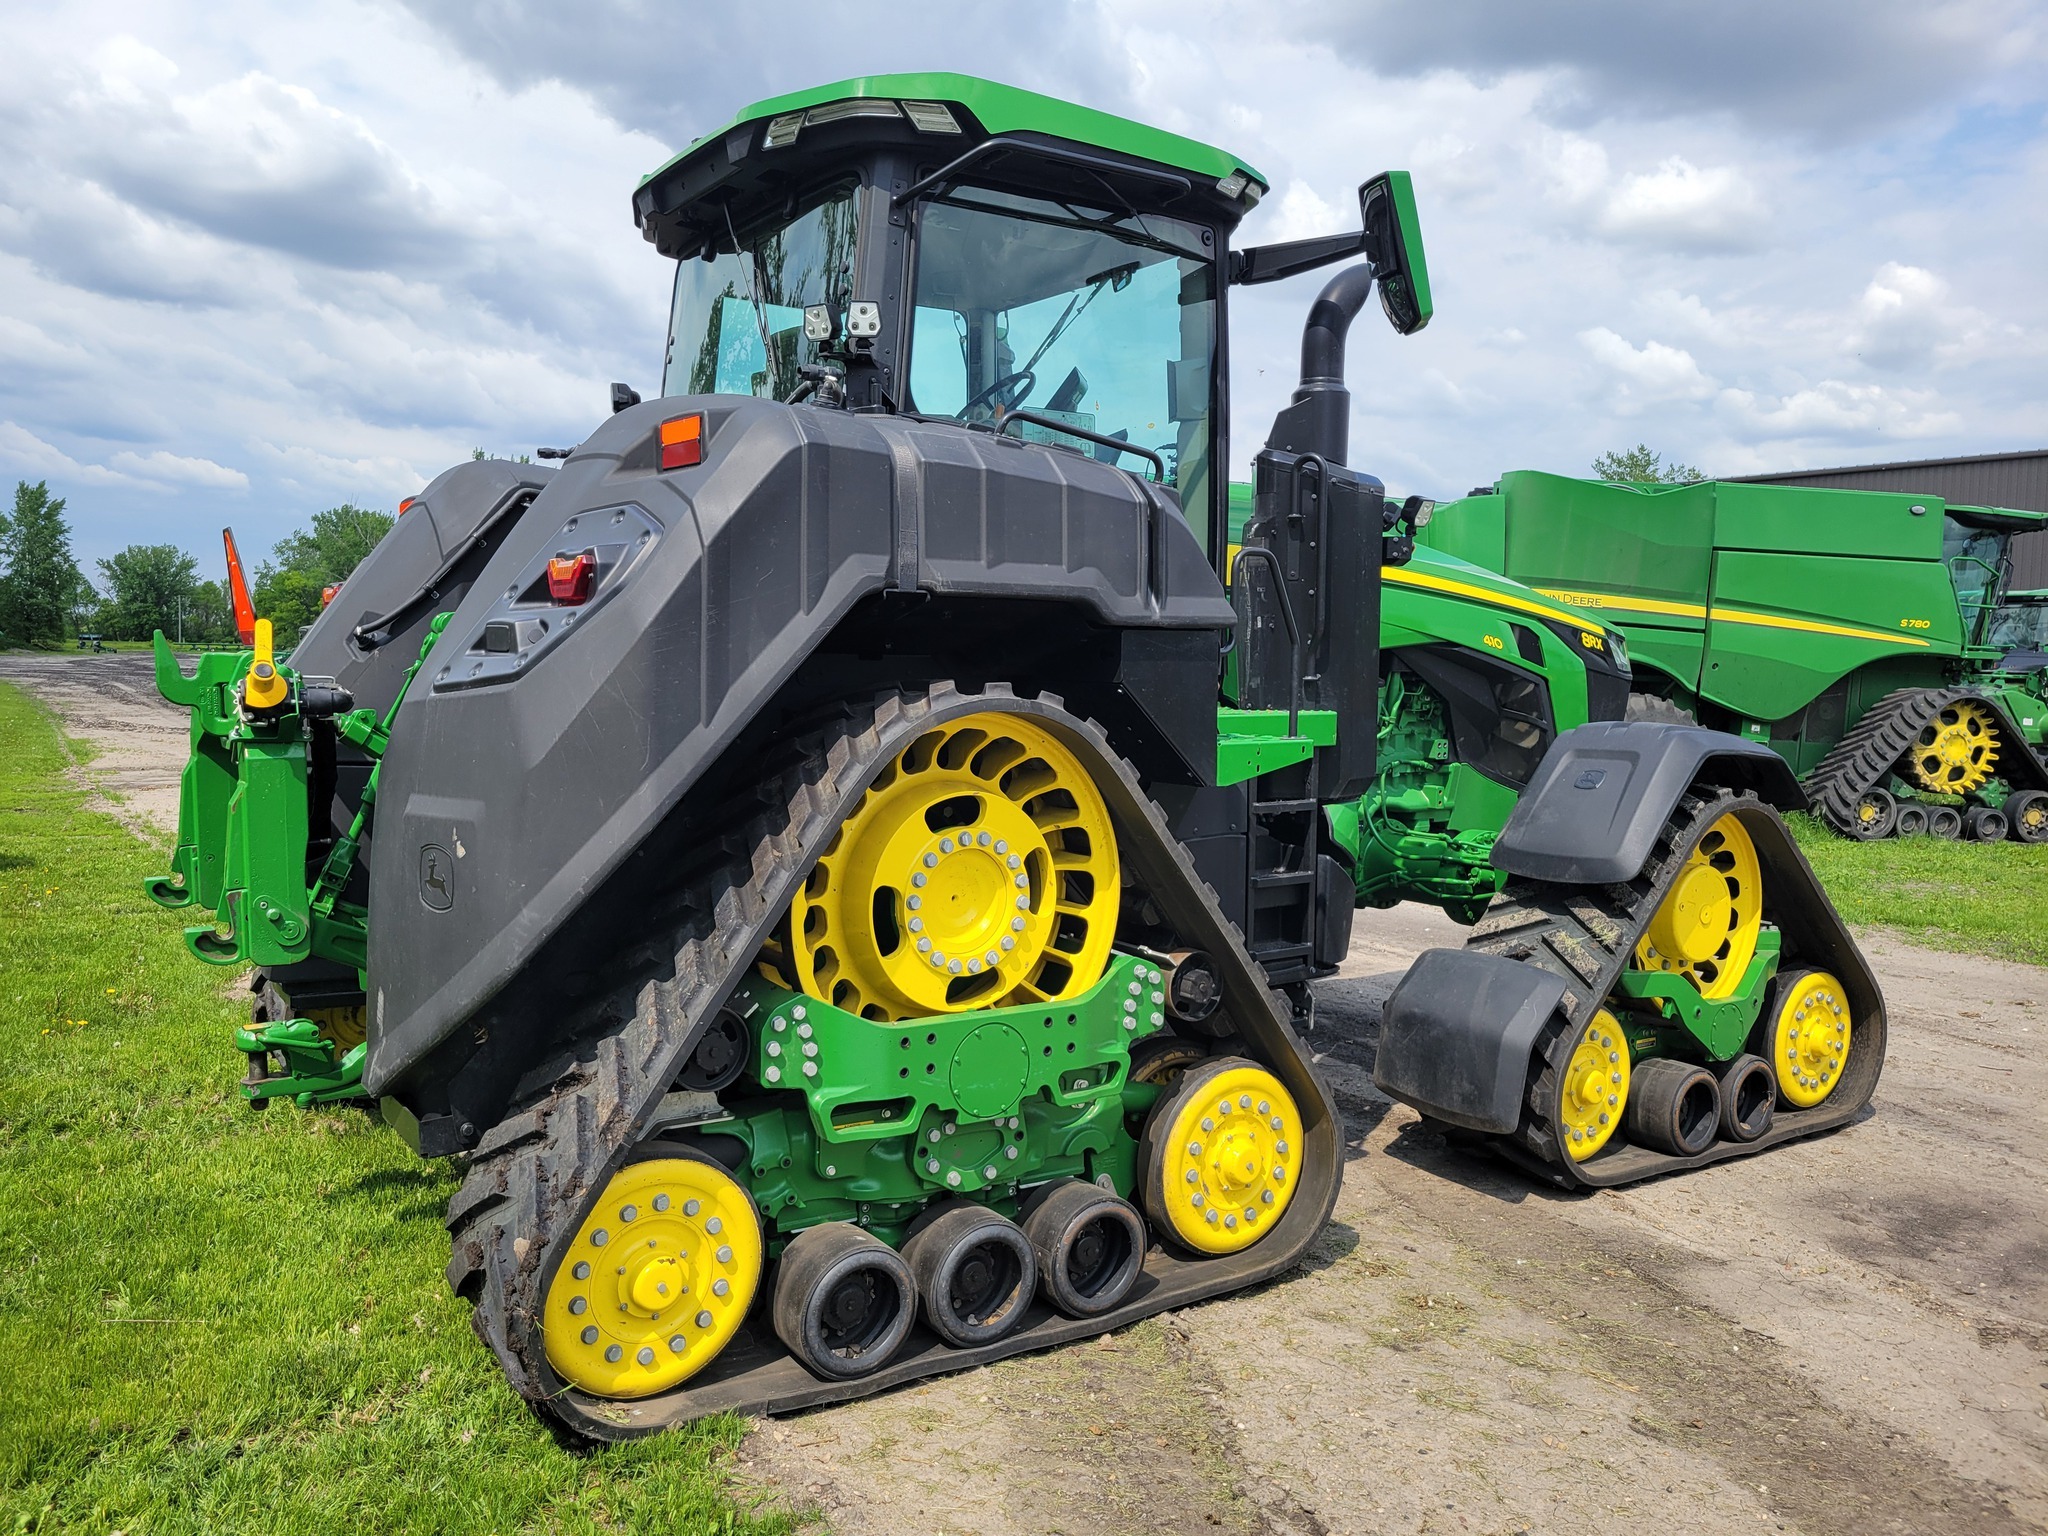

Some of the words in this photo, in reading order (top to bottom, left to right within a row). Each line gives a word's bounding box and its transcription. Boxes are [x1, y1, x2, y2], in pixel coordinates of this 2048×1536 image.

[1564, 593, 1602, 607] DEERE
[1900, 619, 1930, 629] S780
[1483, 634, 1503, 650] 410
[1581, 632, 1604, 651] 8RX
